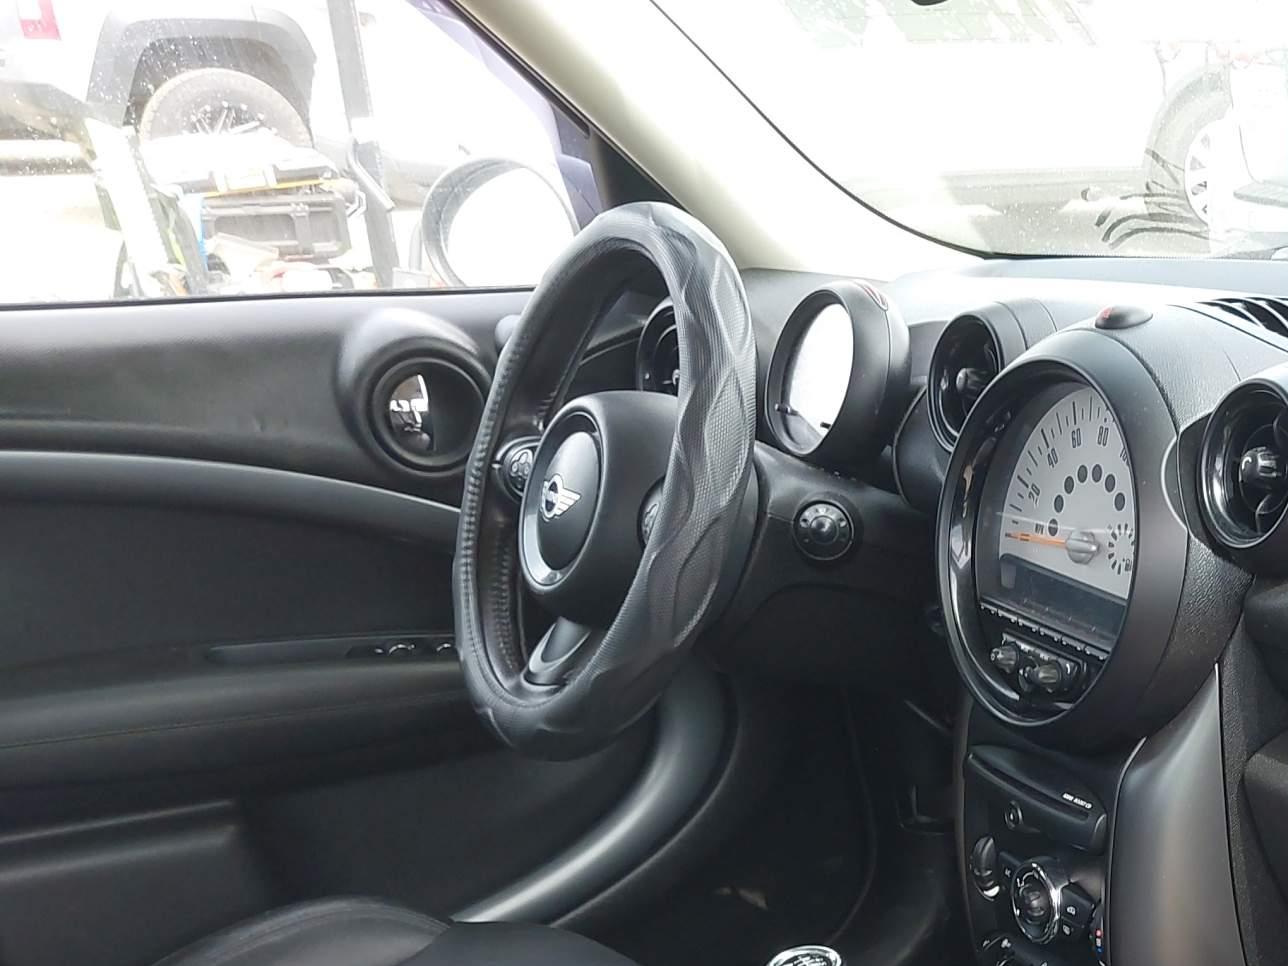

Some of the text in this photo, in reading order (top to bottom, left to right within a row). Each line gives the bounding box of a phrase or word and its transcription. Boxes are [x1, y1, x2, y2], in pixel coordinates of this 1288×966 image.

[1071, 428, 1082, 448] 60
[1098, 426, 1109, 447] 80
[1047, 448, 1059, 468] 40
[1028, 483, 1041, 505] 20
